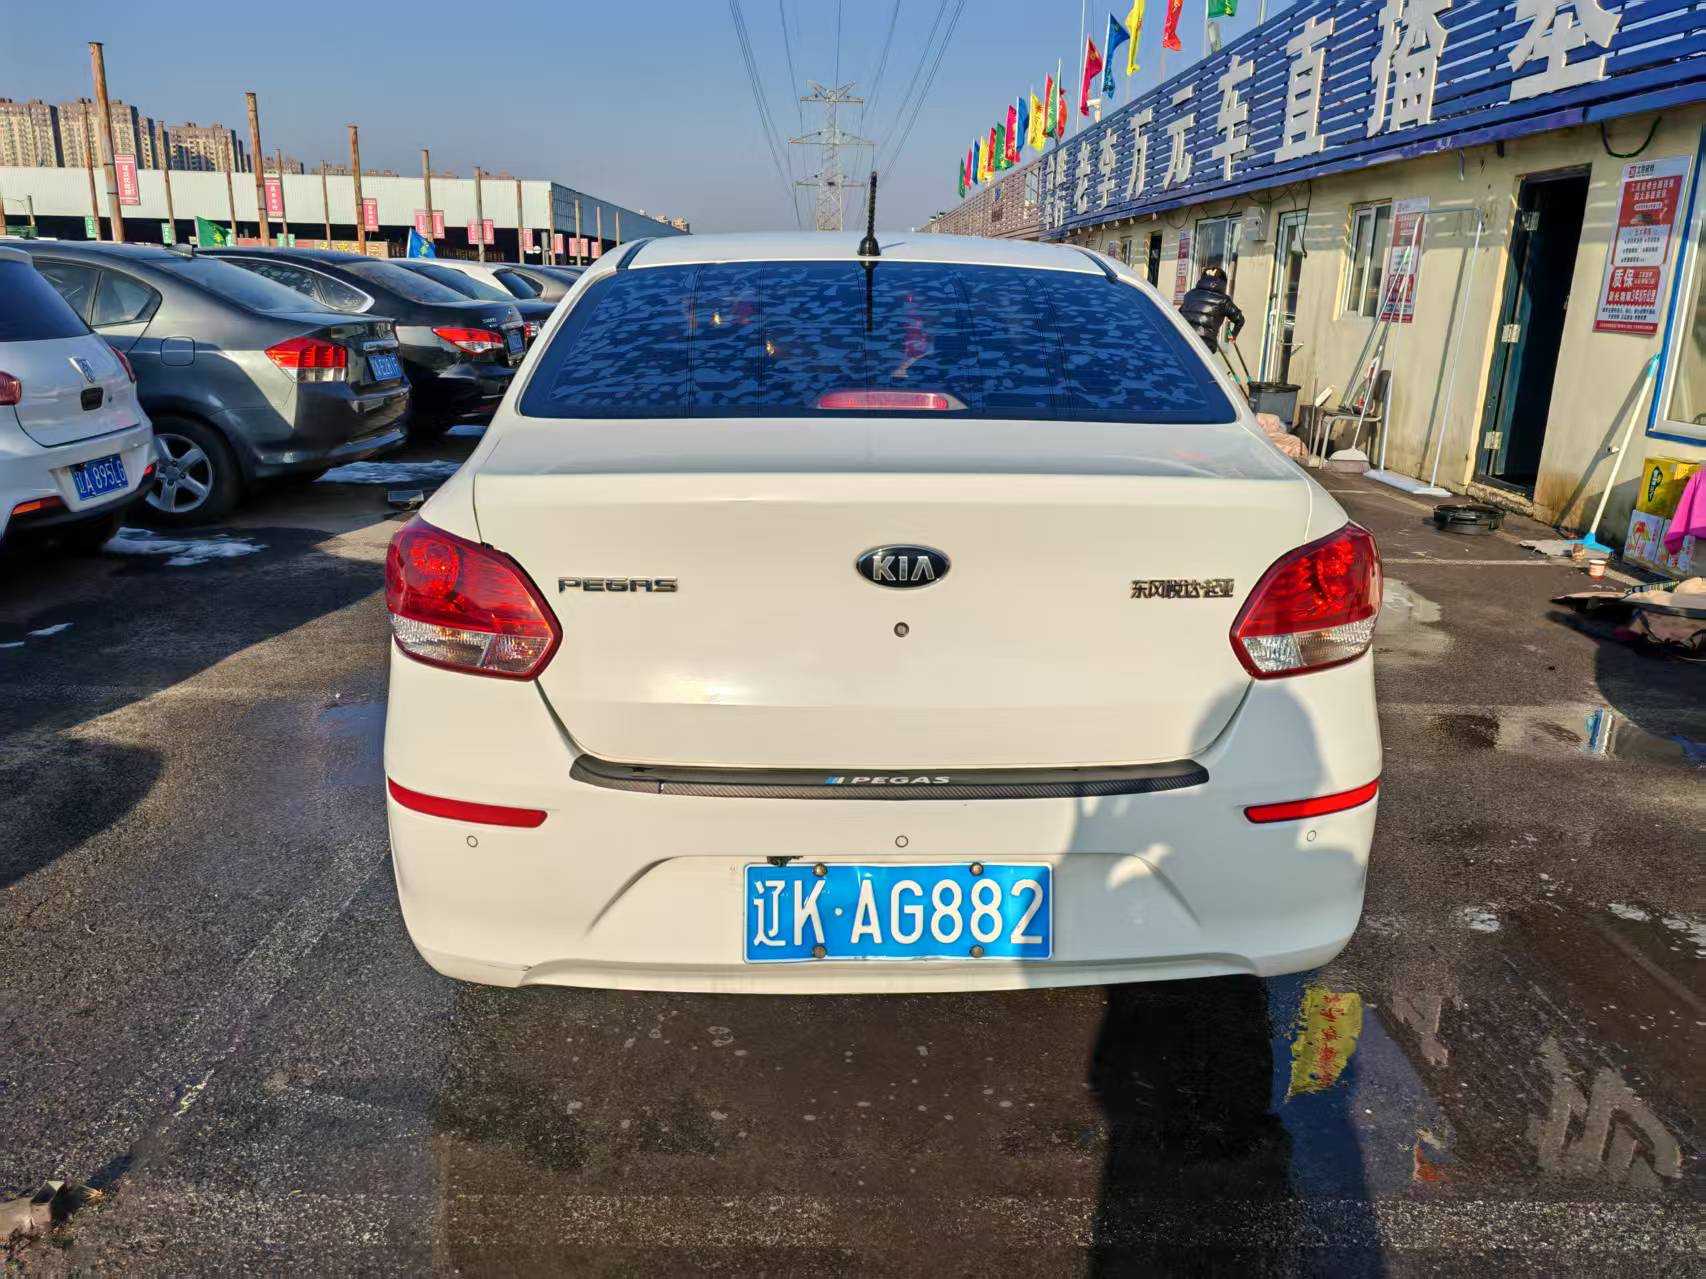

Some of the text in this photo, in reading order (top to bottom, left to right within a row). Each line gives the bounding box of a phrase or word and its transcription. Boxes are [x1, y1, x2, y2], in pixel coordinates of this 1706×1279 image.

[872, 555, 936, 581] KIA
[559, 576, 679, 593] PEGAS
[851, 776, 950, 784] PEGAS
